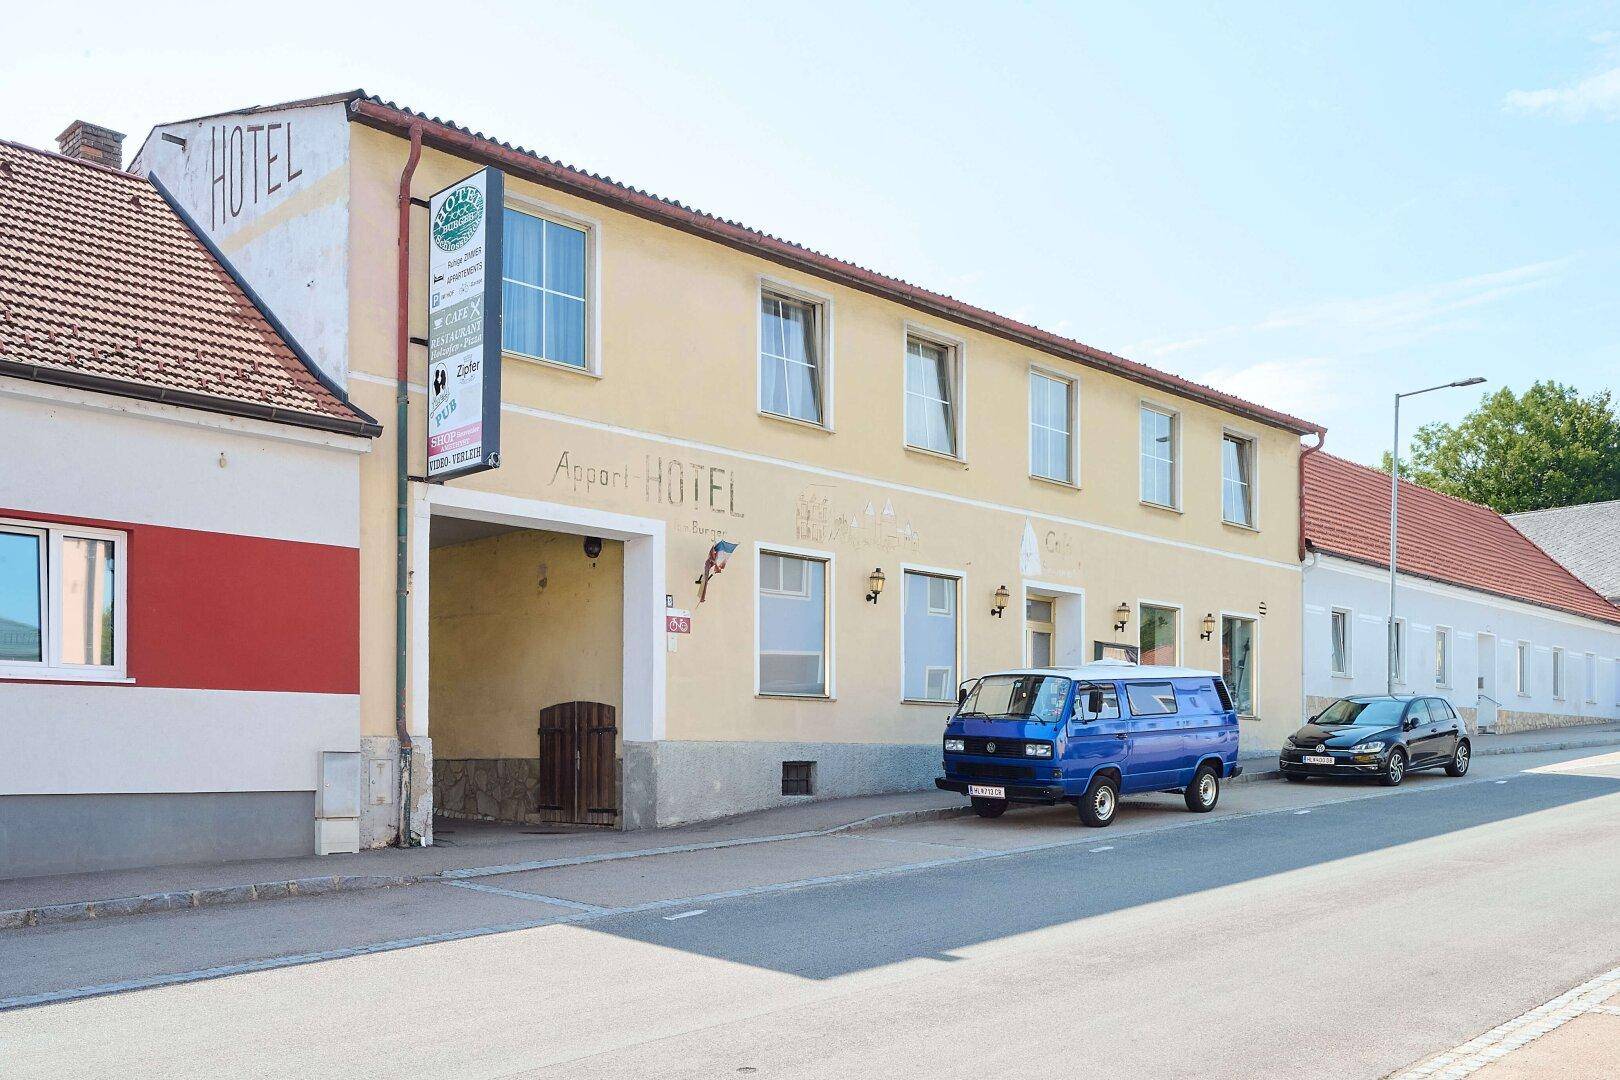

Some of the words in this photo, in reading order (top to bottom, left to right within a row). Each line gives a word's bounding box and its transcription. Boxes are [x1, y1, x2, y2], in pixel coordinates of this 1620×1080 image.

[212, 122, 303, 231] HOTEL
[435, 186, 482, 226] HOTEL
[443, 212, 477, 232] BURGER
[447, 261, 483, 285] APPARTEMENTS
[431, 320, 481, 349] RESTAURANT
[457, 360, 480, 378] Zipfer
[435, 399, 457, 427] PUB
[431, 431, 457, 448] SHOP
[452, 446, 481, 465] VERLEIH
[692, 520, 728, 542] Burger
